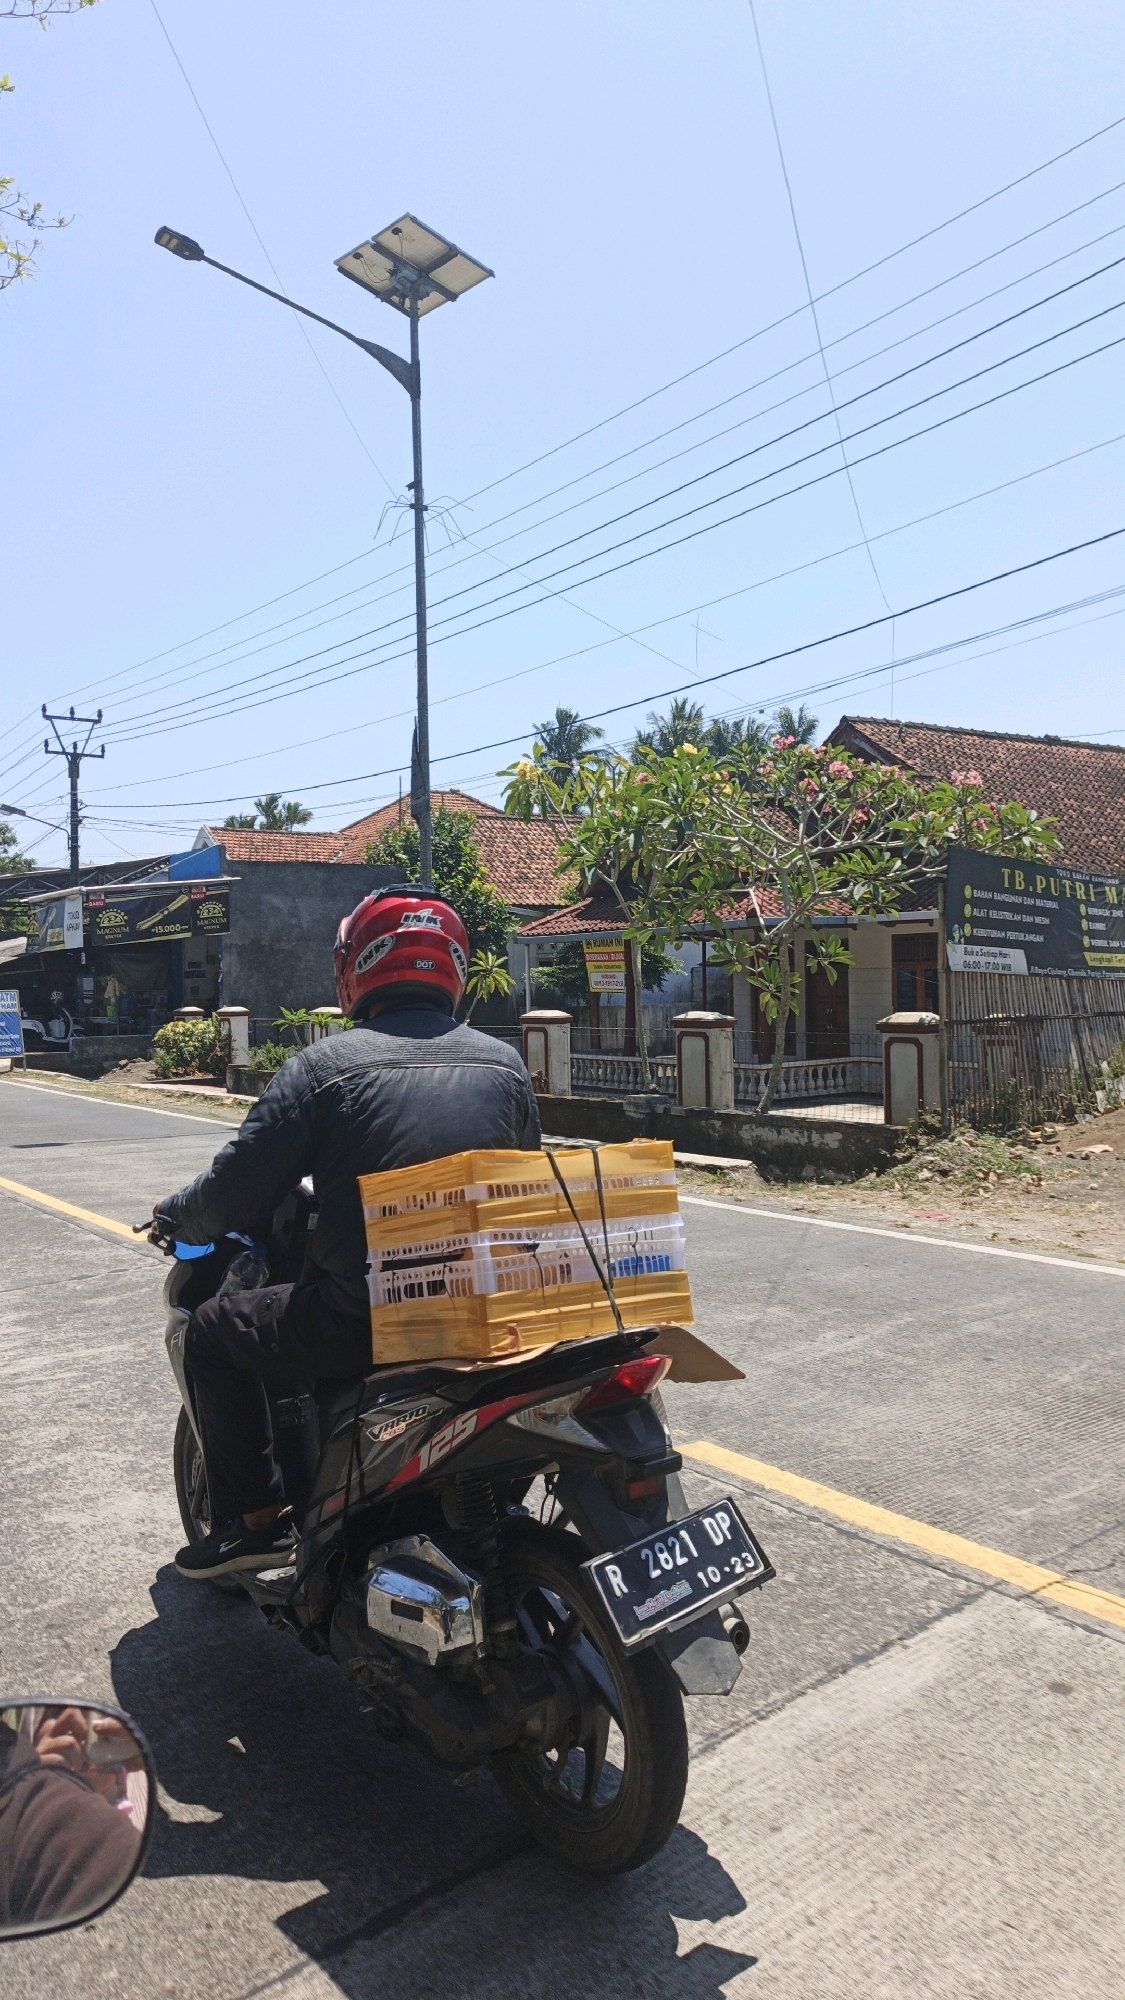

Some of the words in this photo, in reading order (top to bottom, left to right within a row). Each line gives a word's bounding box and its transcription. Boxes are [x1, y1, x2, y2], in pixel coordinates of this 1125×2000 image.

[973, 889, 993, 900] BAHAN
[993, 892, 1023, 904] BANGUNAN
[1023, 896, 1035, 905] DAN
[1035, 898, 1059, 909] MATERIAL
[197, 917, 227, 927] MAGNUM
[973, 907, 988, 917] ALAT
[989, 909, 1021, 921] KELISTRIKAN
[1022, 914, 1034, 923] DAN
[96, 926, 130, 936] MAGNUM
[973, 928, 1006, 938] KEBUTUHAN
[1006, 931, 1044, 942] PERTUKANGAN
[593, 938, 614, 948] RUMAH
[357, 938, 390, 970] INK
[963, 947, 979, 957] Buka
[980, 948, 998, 960] Setiap
[999, 950, 1011, 959] Hari
[416, 960, 434, 969] DOT
[1001, 962, 1012, 972] WIB
[0, 992, 17, 1003] ATM
[170, 1329, 183, 1353] FI
[367, 1405, 429, 1440] VARIO
[418, 1408, 480, 1474] 125
[605, 1564, 629, 1598] R
[641, 1529, 699, 1580] 2821
[701, 1511, 732, 1546] DP
